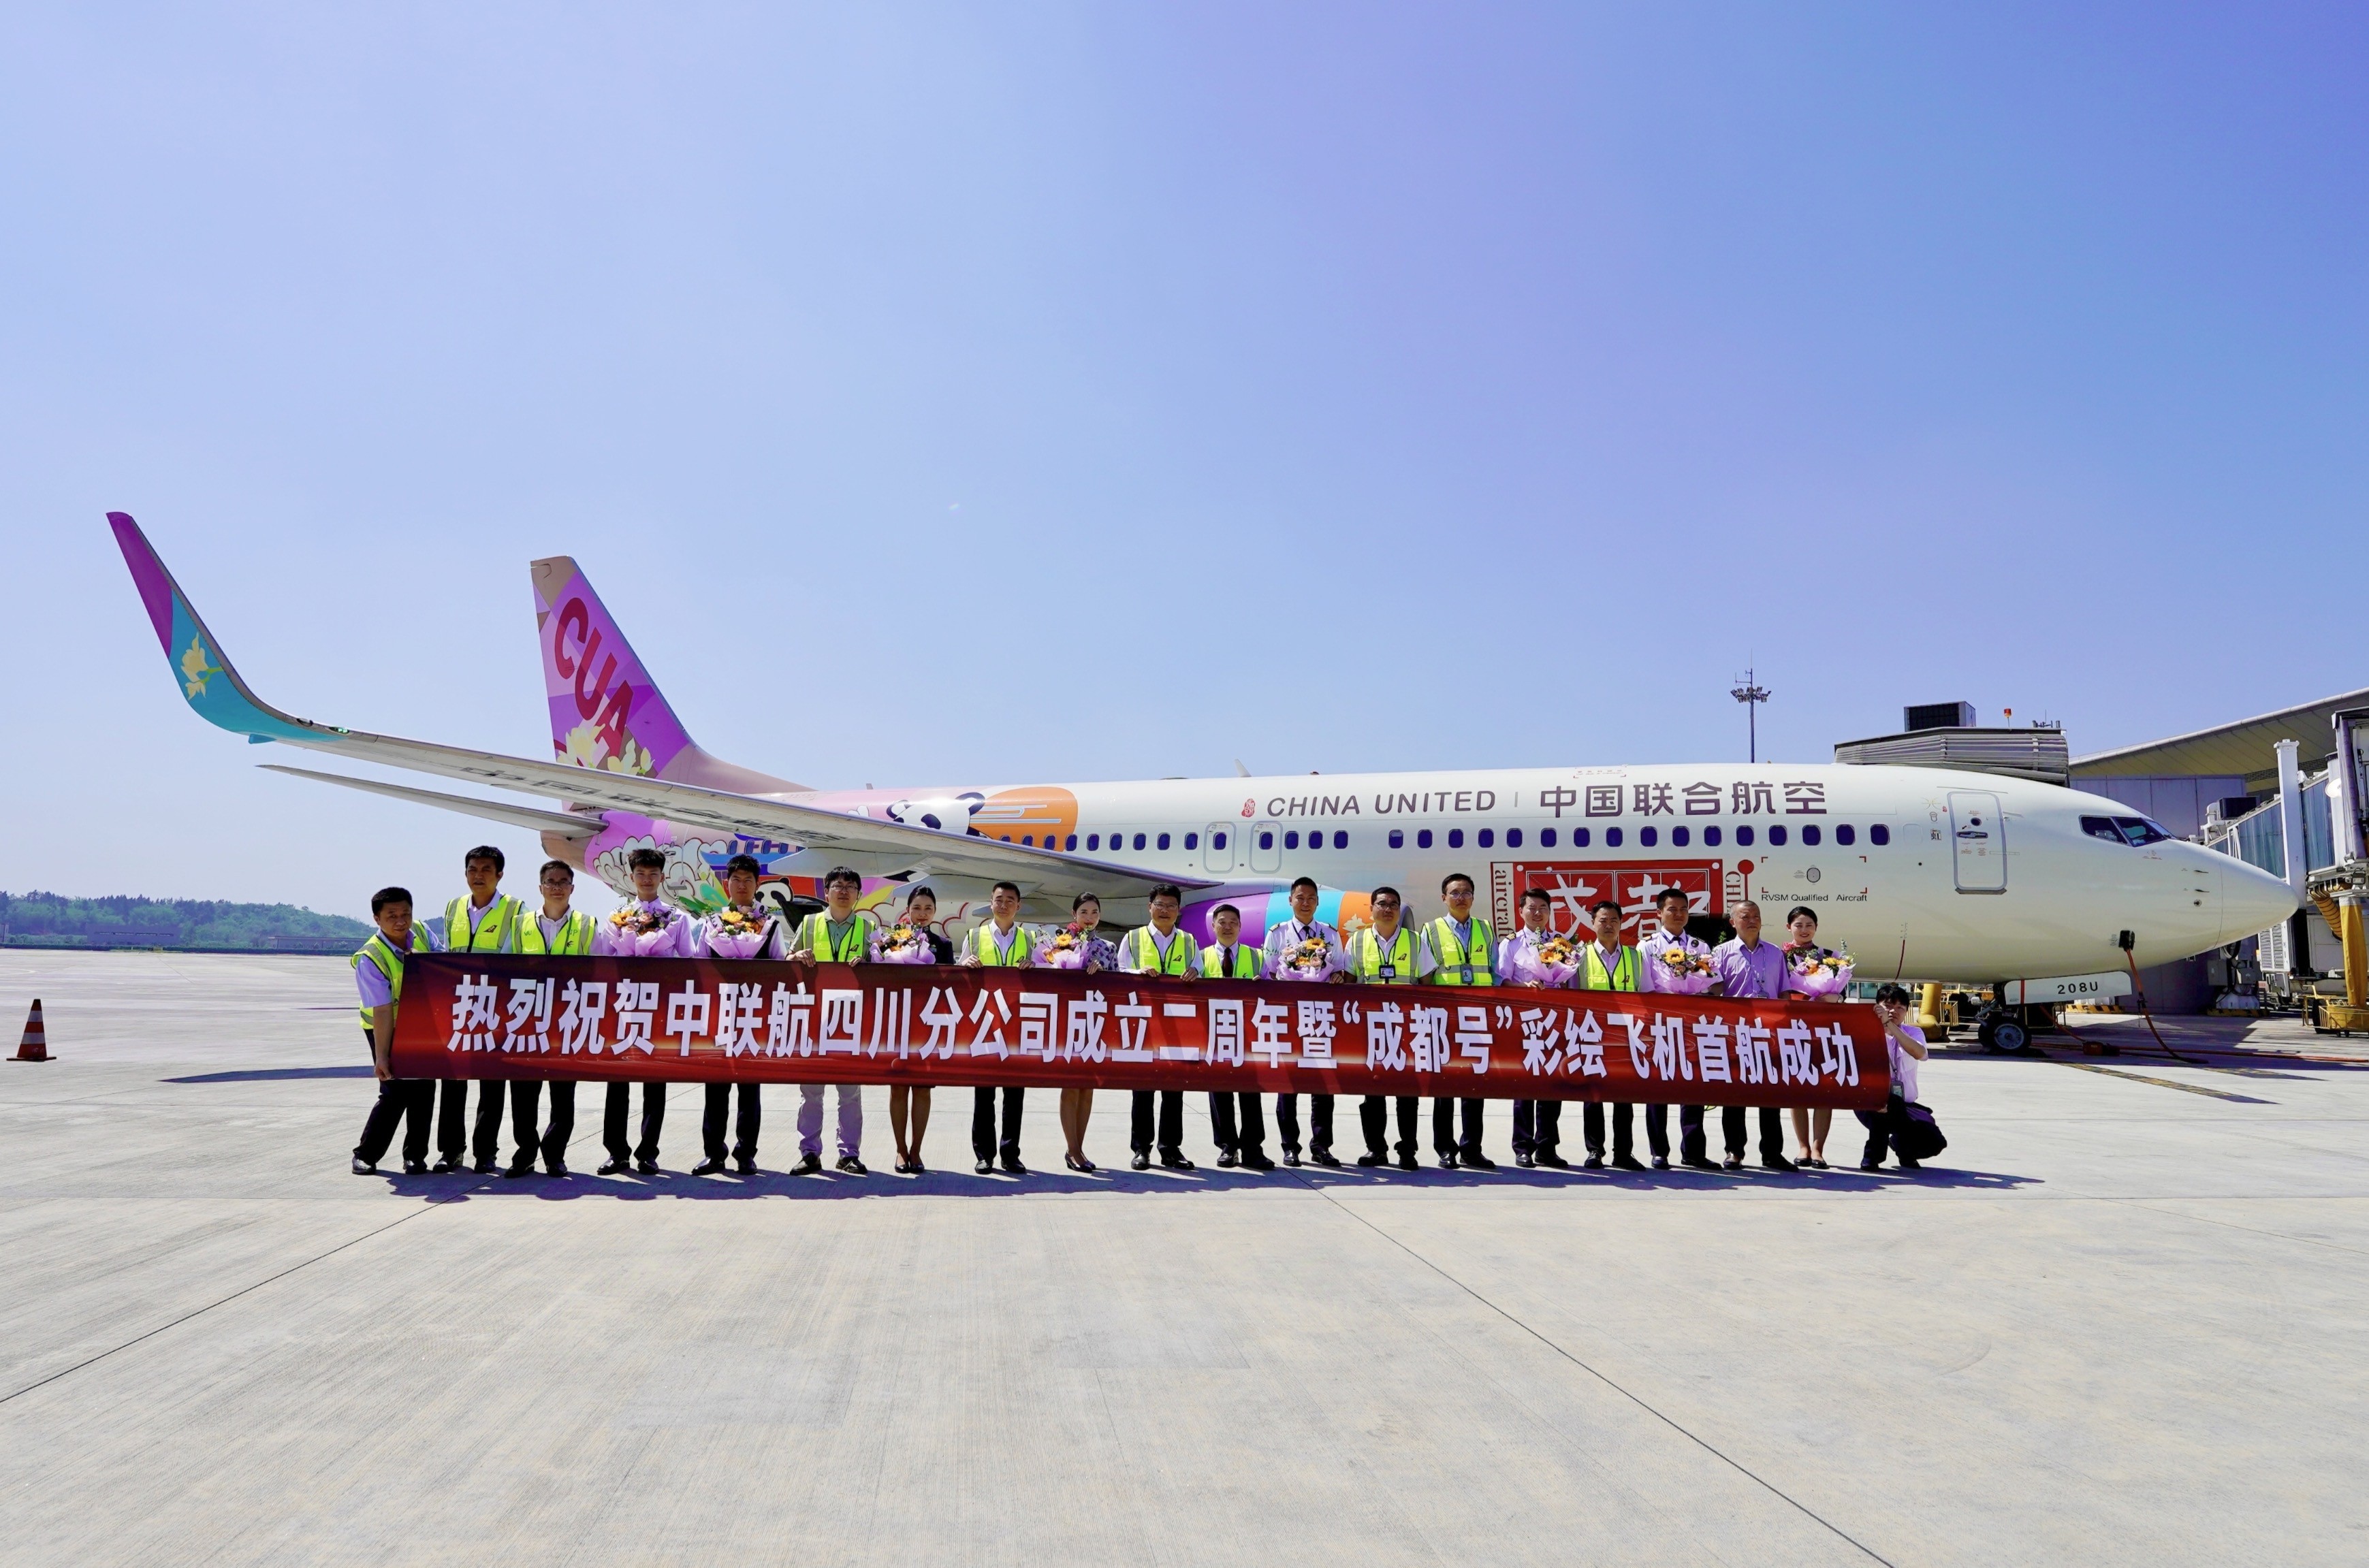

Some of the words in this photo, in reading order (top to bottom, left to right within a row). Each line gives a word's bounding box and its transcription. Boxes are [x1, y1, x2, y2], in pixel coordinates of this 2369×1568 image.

[554, 597, 634, 758] CUA
[1267, 795, 1361, 817] CHINA
[1374, 790, 1496, 814] UNITED
[1539, 781, 1828, 818] 中国联合航空
[1495, 869, 1514, 939] aircraft
[1791, 893, 1828, 902] Qualified
[1836, 893, 1867, 901] Aircraft
[2057, 981, 2098, 995] 208U
[447, 974, 1860, 1087] 热烈祝贺中联航四川分公司成立二周年暨“成都号”彩绘飞机首航成功
